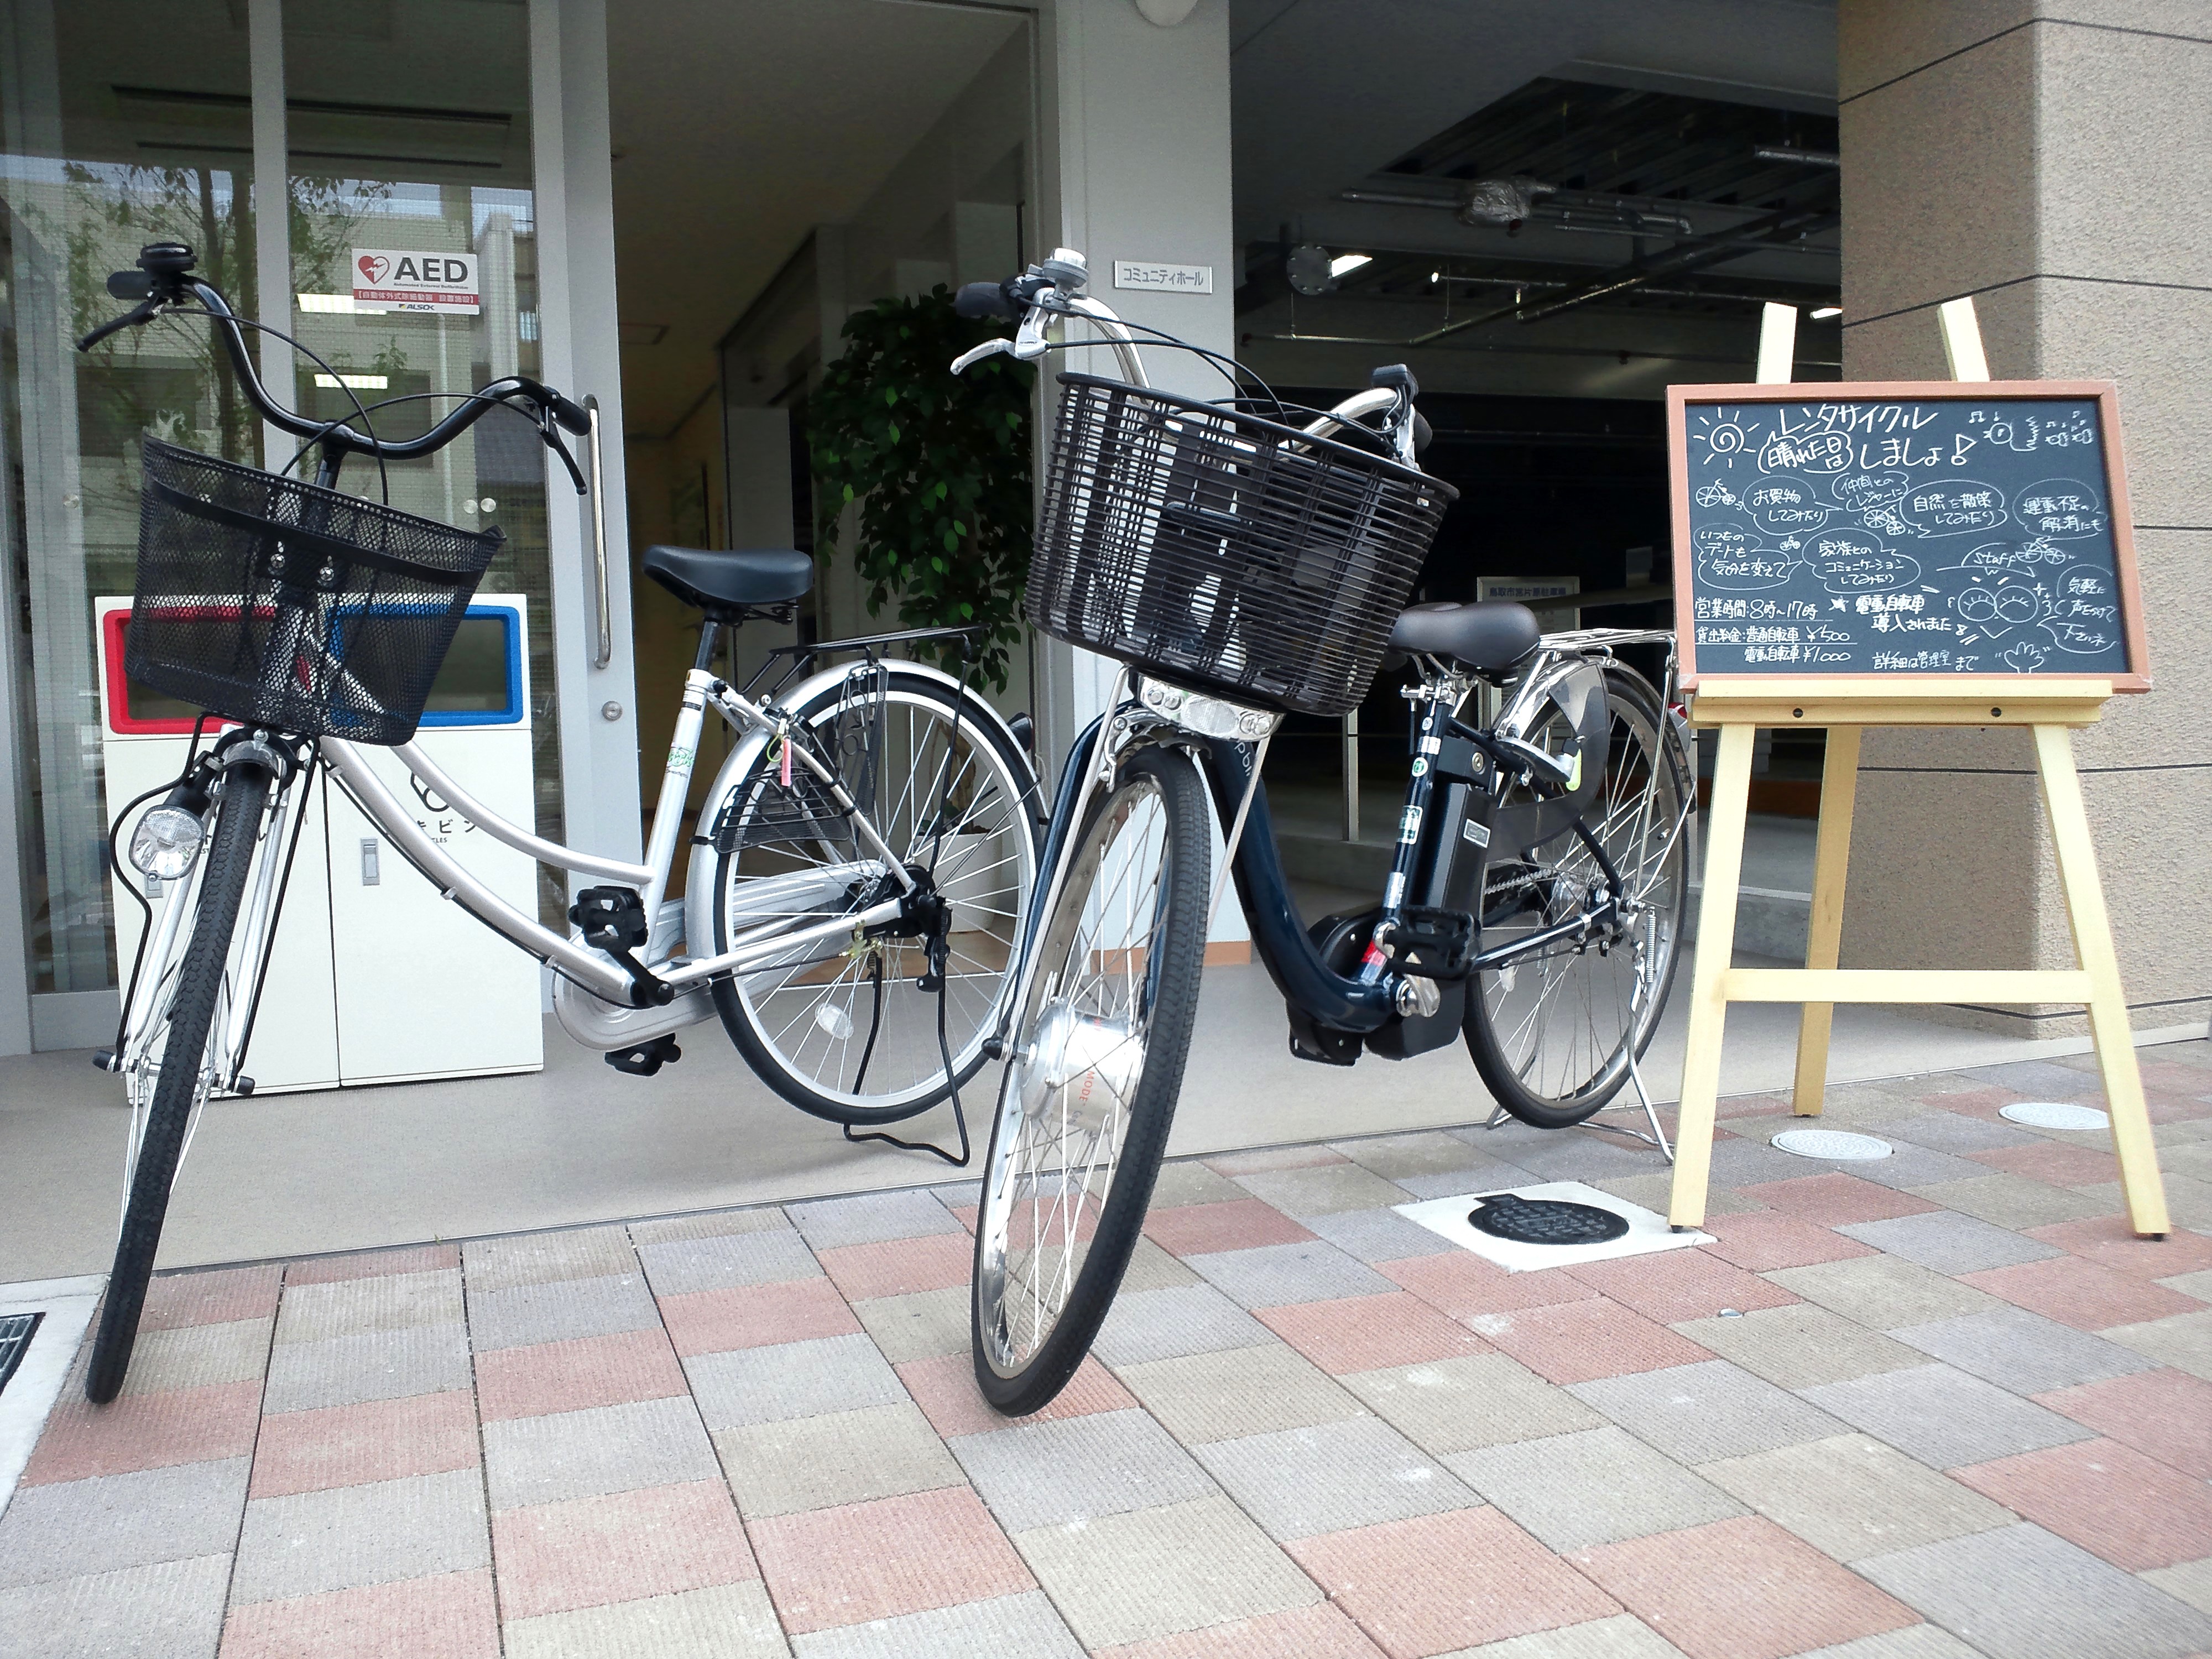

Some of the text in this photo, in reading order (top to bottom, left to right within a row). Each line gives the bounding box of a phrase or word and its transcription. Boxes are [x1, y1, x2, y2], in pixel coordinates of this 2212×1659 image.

[394, 257, 468, 283] AED
[1123, 268, 1204, 286] コミュニティホール
[1780, 403, 1939, 435] レンタサイクル
[1752, 488, 1802, 507] お買物
[1913, 491, 1992, 512] 自然を散策
[2022, 495, 2089, 515] 運動不足の
[1768, 509, 1823, 522] してみたり
[1936, 510, 1994, 526] してみたり
[2038, 514, 2104, 533] 解消にも
[1700, 531, 1745, 542] いつもの
[1705, 542, 1747, 559] デートも
[1818, 540, 1872, 557] 家族との
[1711, 557, 1787, 578] 気分を変えて
[1825, 559, 1905, 573] コミュニケーション
[1855, 593, 1925, 615] 電動自転車
